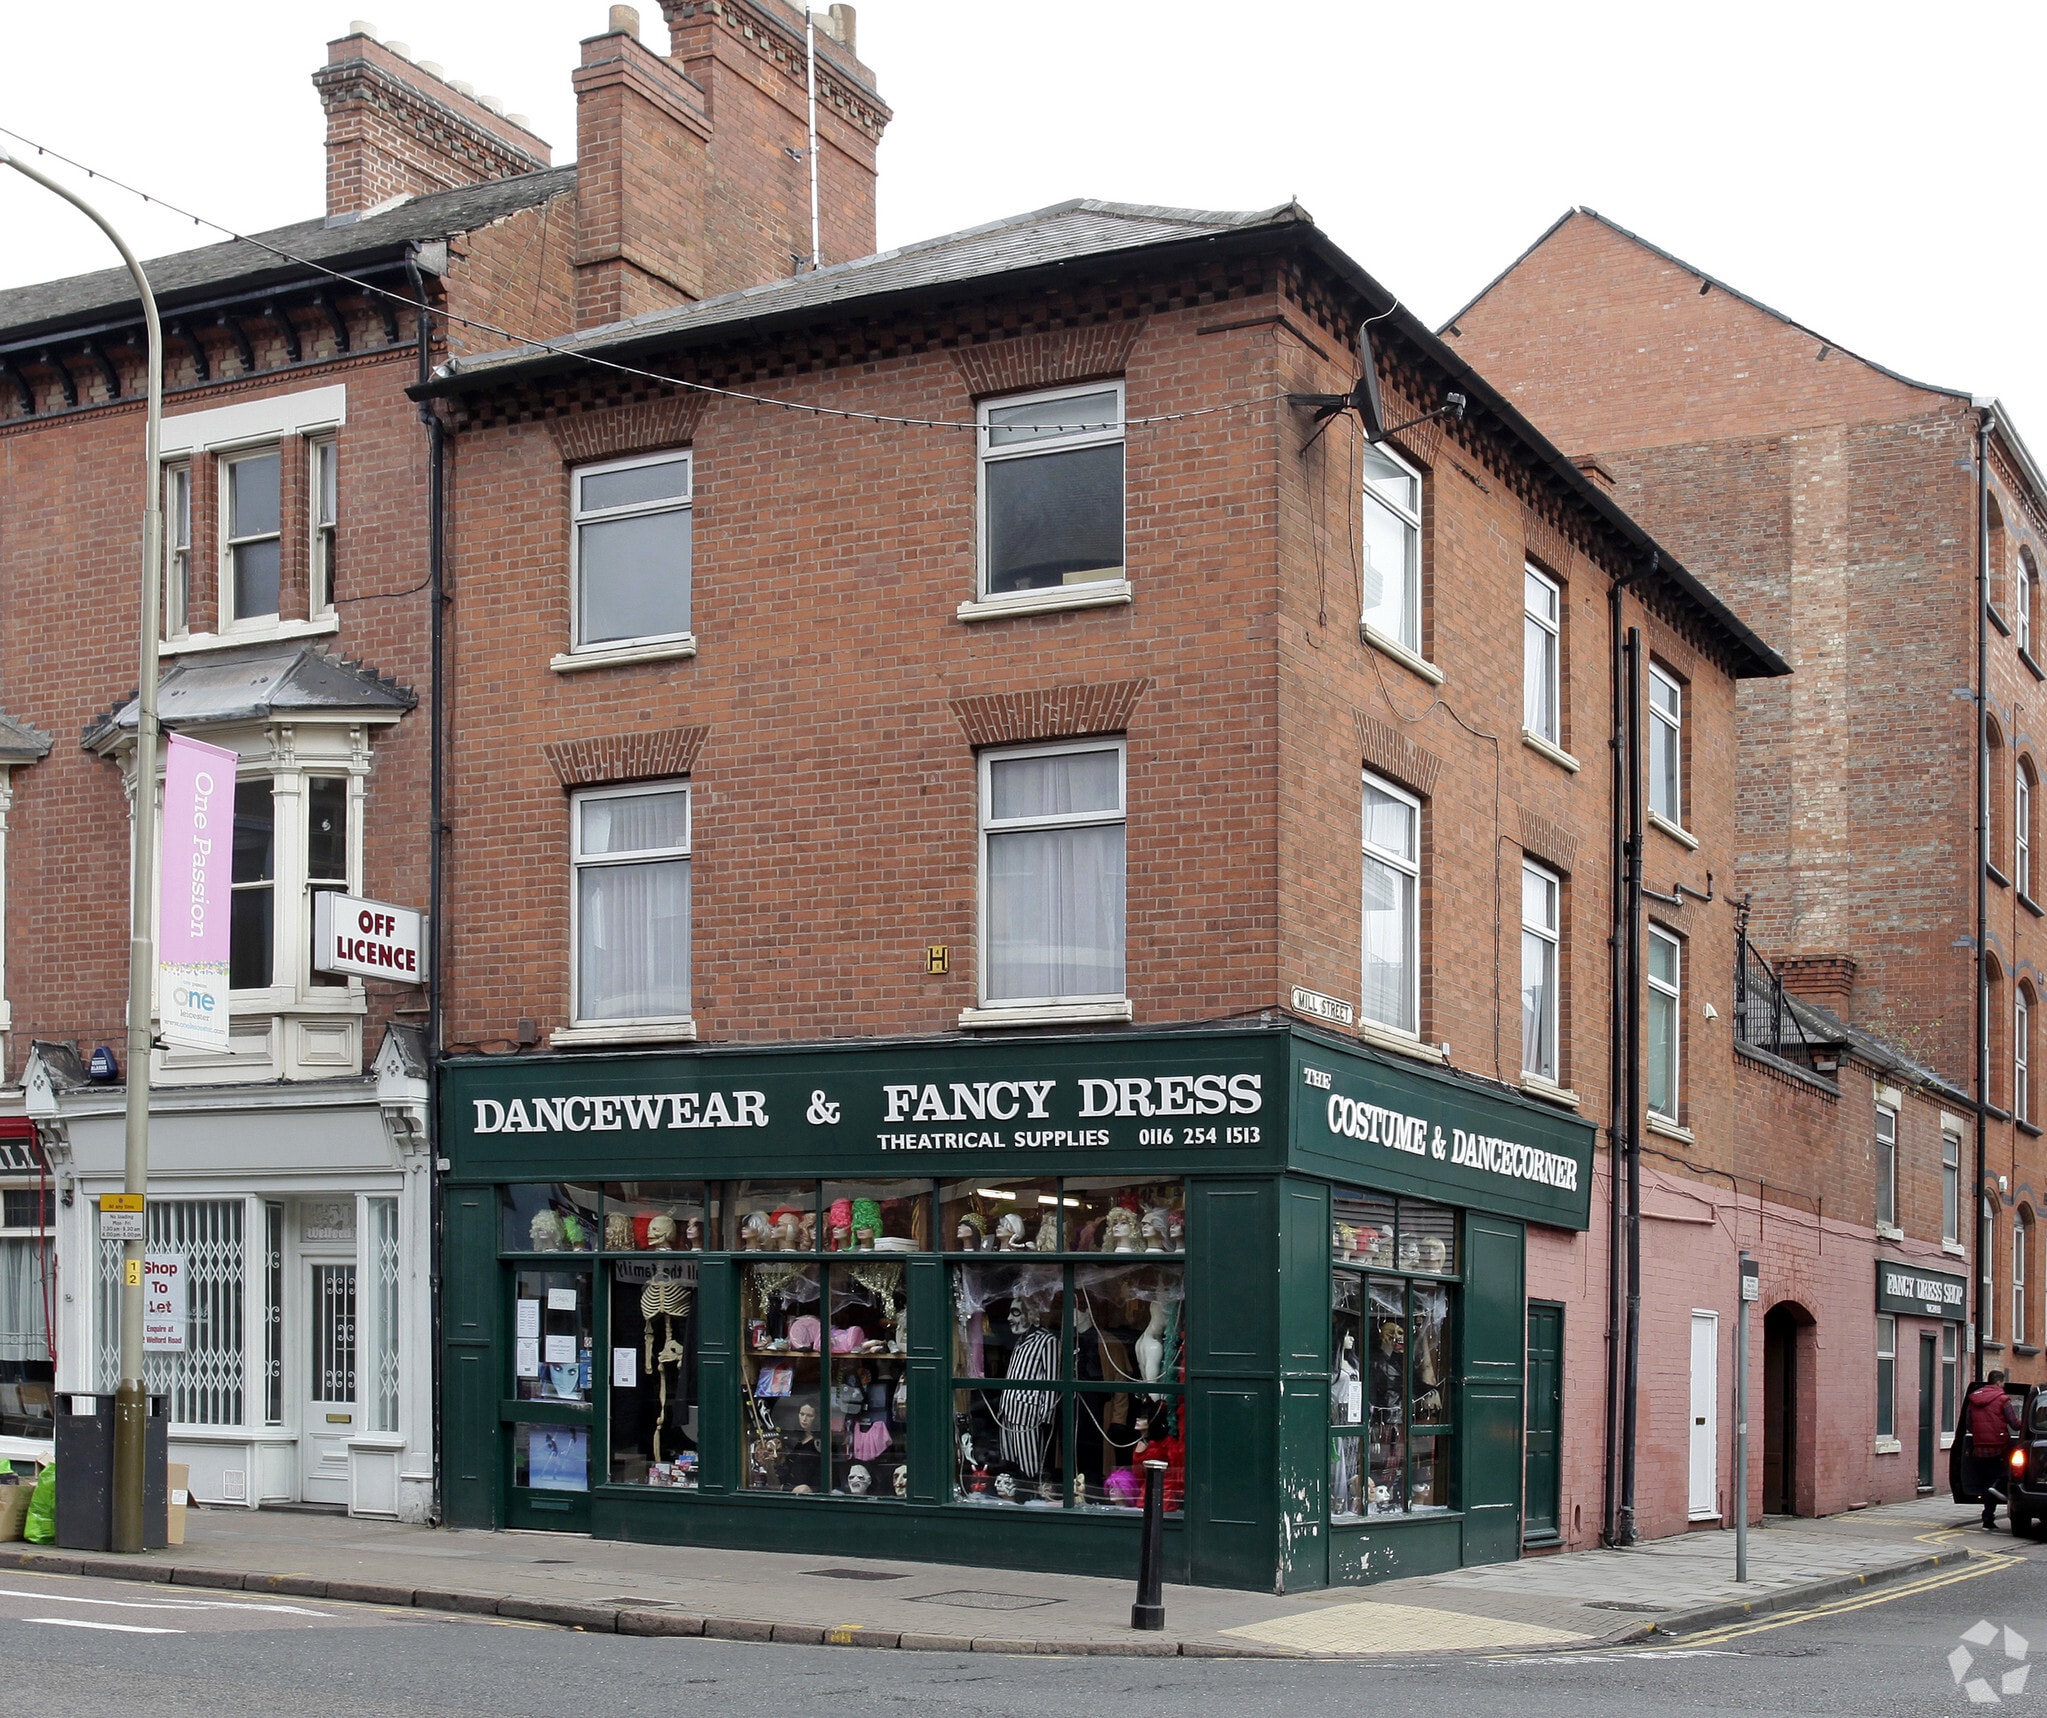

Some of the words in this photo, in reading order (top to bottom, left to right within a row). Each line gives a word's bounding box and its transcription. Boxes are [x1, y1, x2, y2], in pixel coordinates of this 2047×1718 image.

[195, 771, 214, 829] One
[190, 834, 212, 938] Passion
[358, 910, 396, 937] OFF
[337, 936, 416, 972] LICENCE
[930, 947, 945, 971] H
[173, 987, 215, 1011] one
[1298, 991, 1317, 1012] MILL
[1321, 1000, 1349, 1022] STREET
[1303, 1067, 1331, 1090] THE
[473, 1090, 769, 1134] DANCEWEAR
[806, 1089, 841, 1126] &
[883, 1080, 1056, 1122] FANCY
[1078, 1074, 1262, 1118] DRESS
[877, 1132, 1006, 1151] THEATRICAL
[1014, 1129, 1110, 1148] SUPPLIES
[1139, 1128, 1174, 1146] 0116
[1183, 1127, 1217, 1145] 254
[1226, 1126, 1261, 1144] 1513
[1327, 1094, 1428, 1156] COSTUME
[1431, 1126, 1446, 1161] &
[1451, 1128, 1578, 1192] DANCECORNER
[131, 1262, 136, 1271] 1
[145, 1261, 177, 1277] Shop
[129, 1275, 137, 1284] 2
[152, 1281, 168, 1294] To
[1886, 1273, 1915, 1298] FANCY
[1915, 1278, 1943, 1303] DRESS
[1943, 1283, 1963, 1305] SHOP
[149, 1301, 172, 1313] Let
[146, 1325, 167, 1333] Enquire
[168, 1336, 182, 1344] Road
